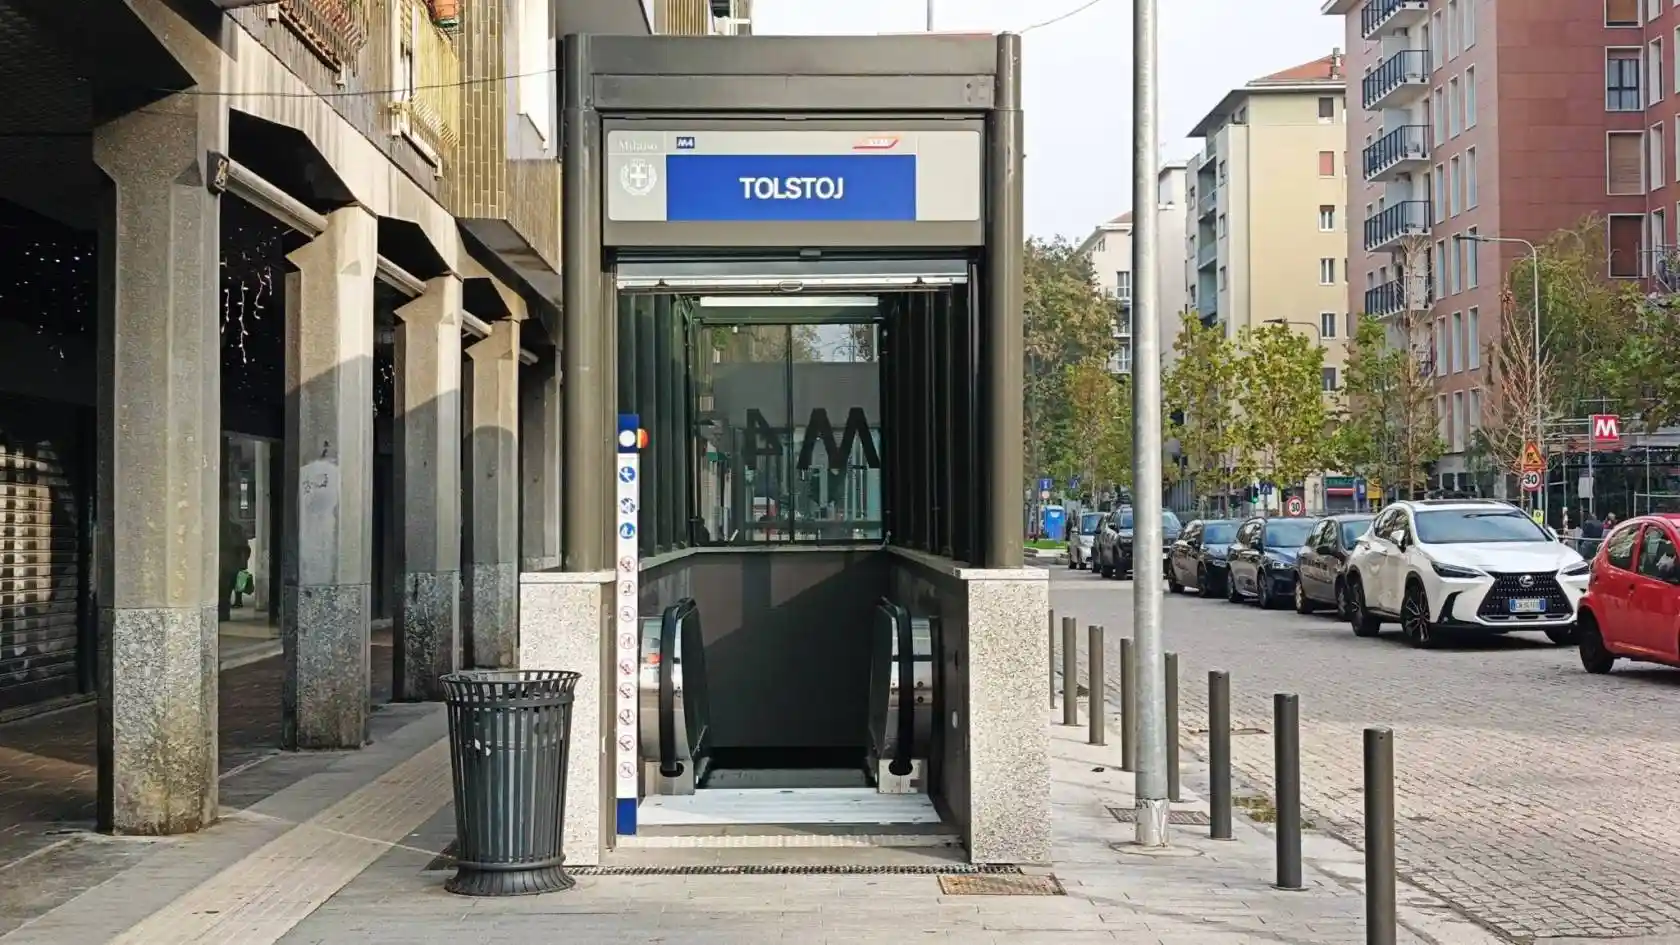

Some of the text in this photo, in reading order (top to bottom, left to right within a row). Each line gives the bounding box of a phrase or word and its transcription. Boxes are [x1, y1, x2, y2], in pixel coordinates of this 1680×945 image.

[619, 139, 658, 152] Milano
[678, 138, 695, 148] M4
[739, 177, 844, 199] TOLSTOJ
[1594, 418, 1619, 437] M
[1524, 474, 1537, 485] 30
[1290, 502, 1300, 512] 30
